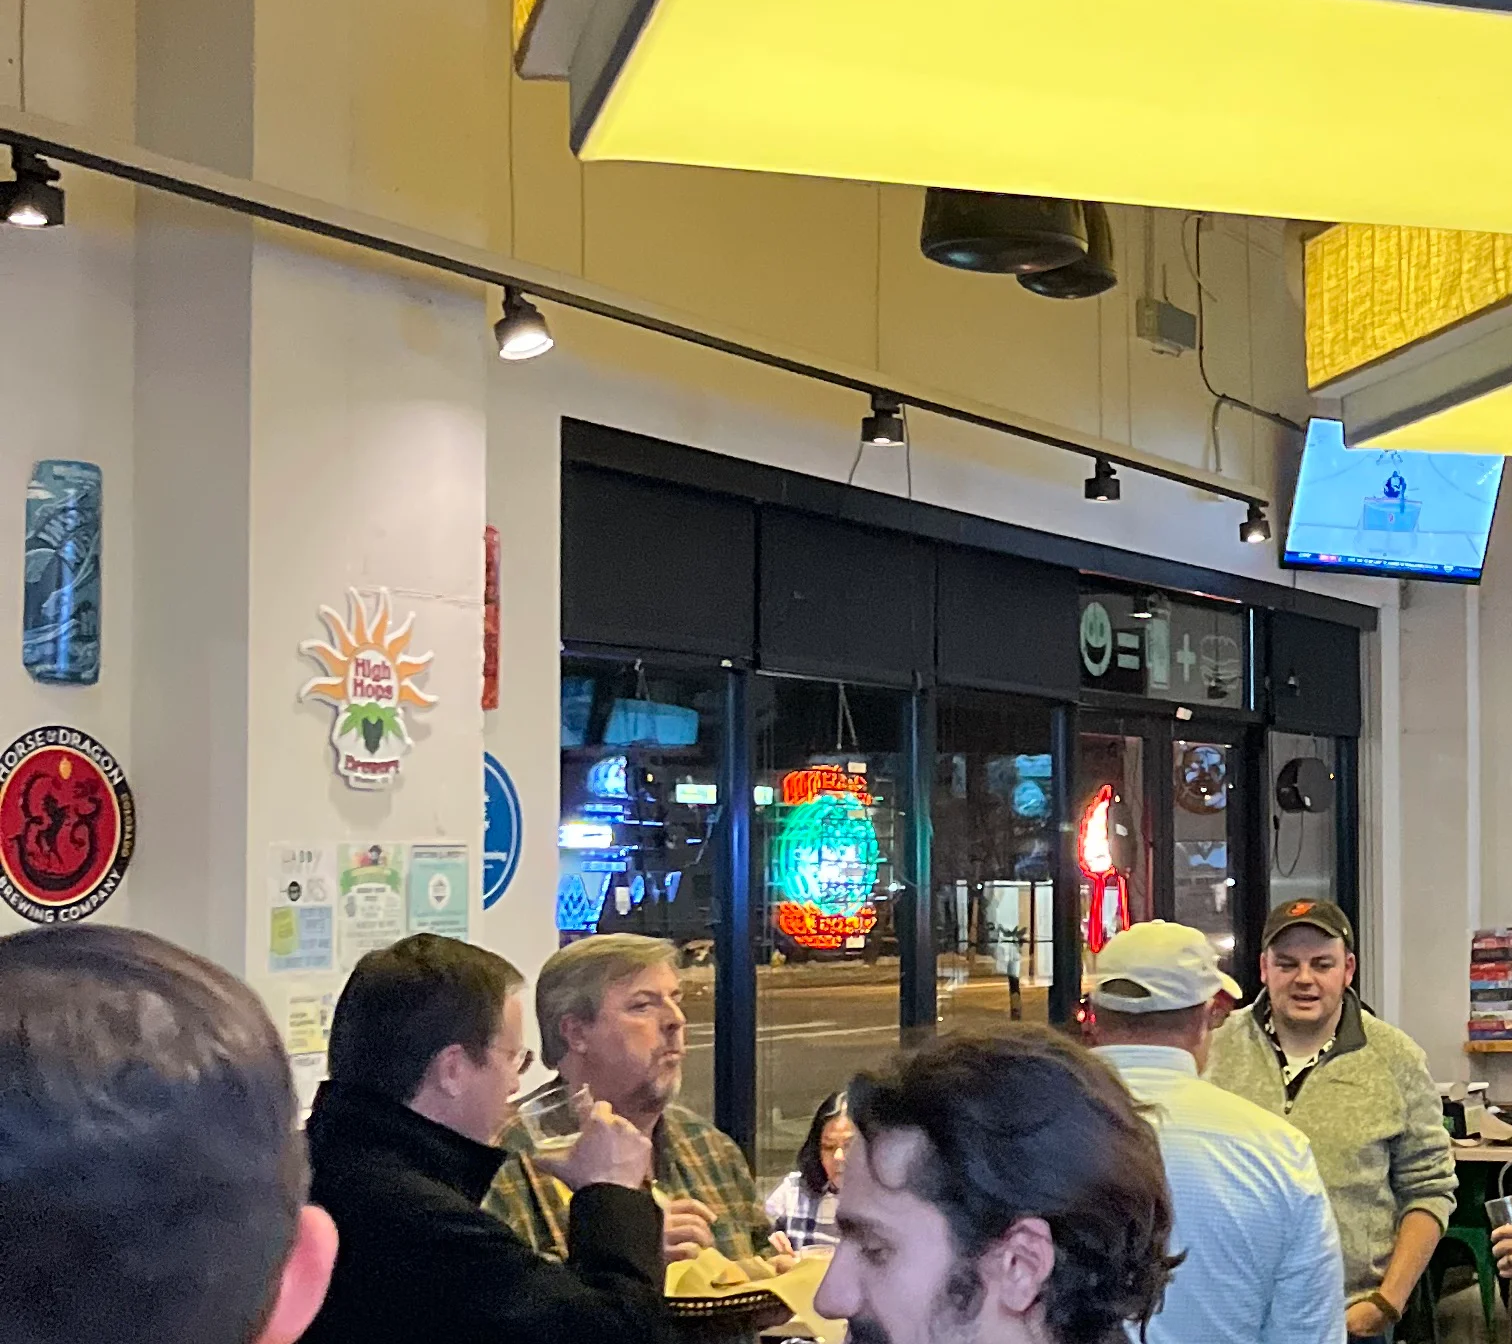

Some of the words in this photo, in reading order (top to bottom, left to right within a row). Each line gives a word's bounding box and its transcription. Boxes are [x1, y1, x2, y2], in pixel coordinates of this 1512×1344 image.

[354, 657, 391, 682] High
[353, 677, 394, 702] Hops
[0, 730, 46, 783] HORSE
[58, 729, 125, 786] DRAGON
[58, 868, 122, 922] COMPANY
